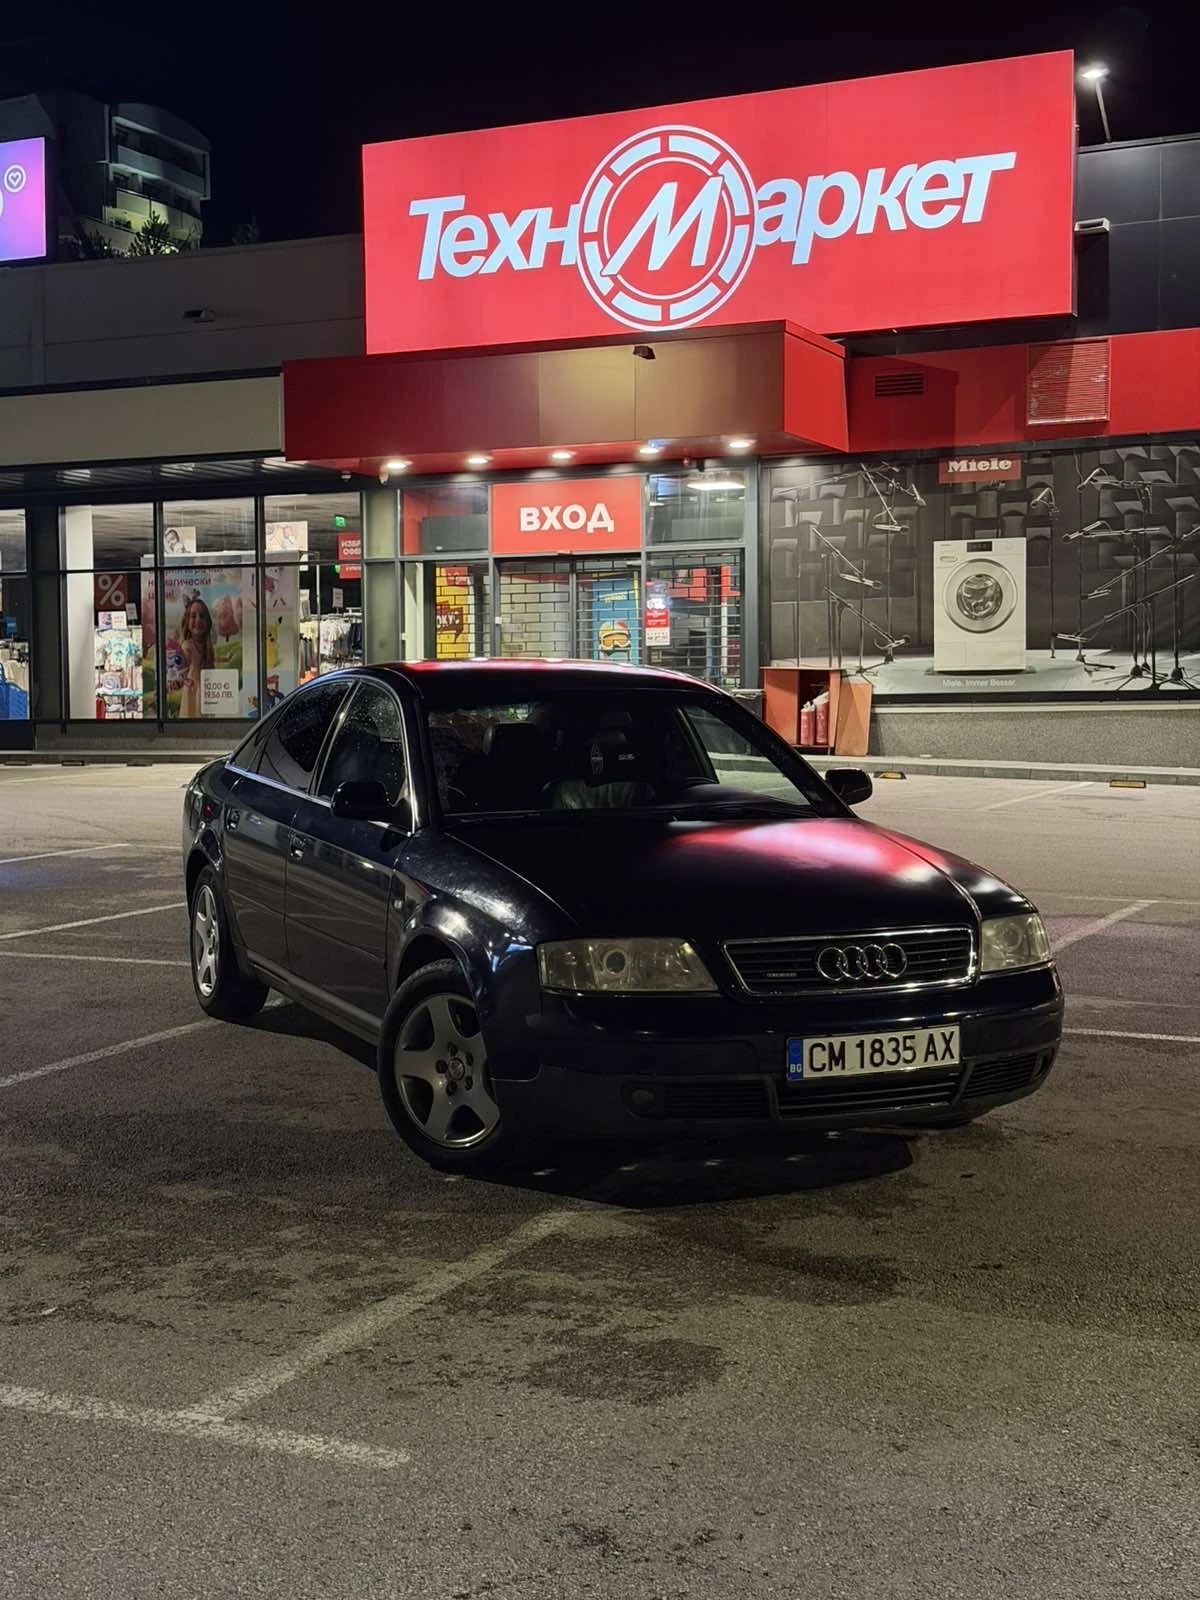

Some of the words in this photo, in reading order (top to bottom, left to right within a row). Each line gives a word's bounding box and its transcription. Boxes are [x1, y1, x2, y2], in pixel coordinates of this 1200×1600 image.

[948, 458, 1012, 472] Miele
[520, 504, 614, 533] ВХОД
[809, 1041, 846, 1072] CM
[856, 1035, 917, 1069] 1835
[924, 1031, 955, 1062] AX
[790, 1064, 802, 1073] BG
